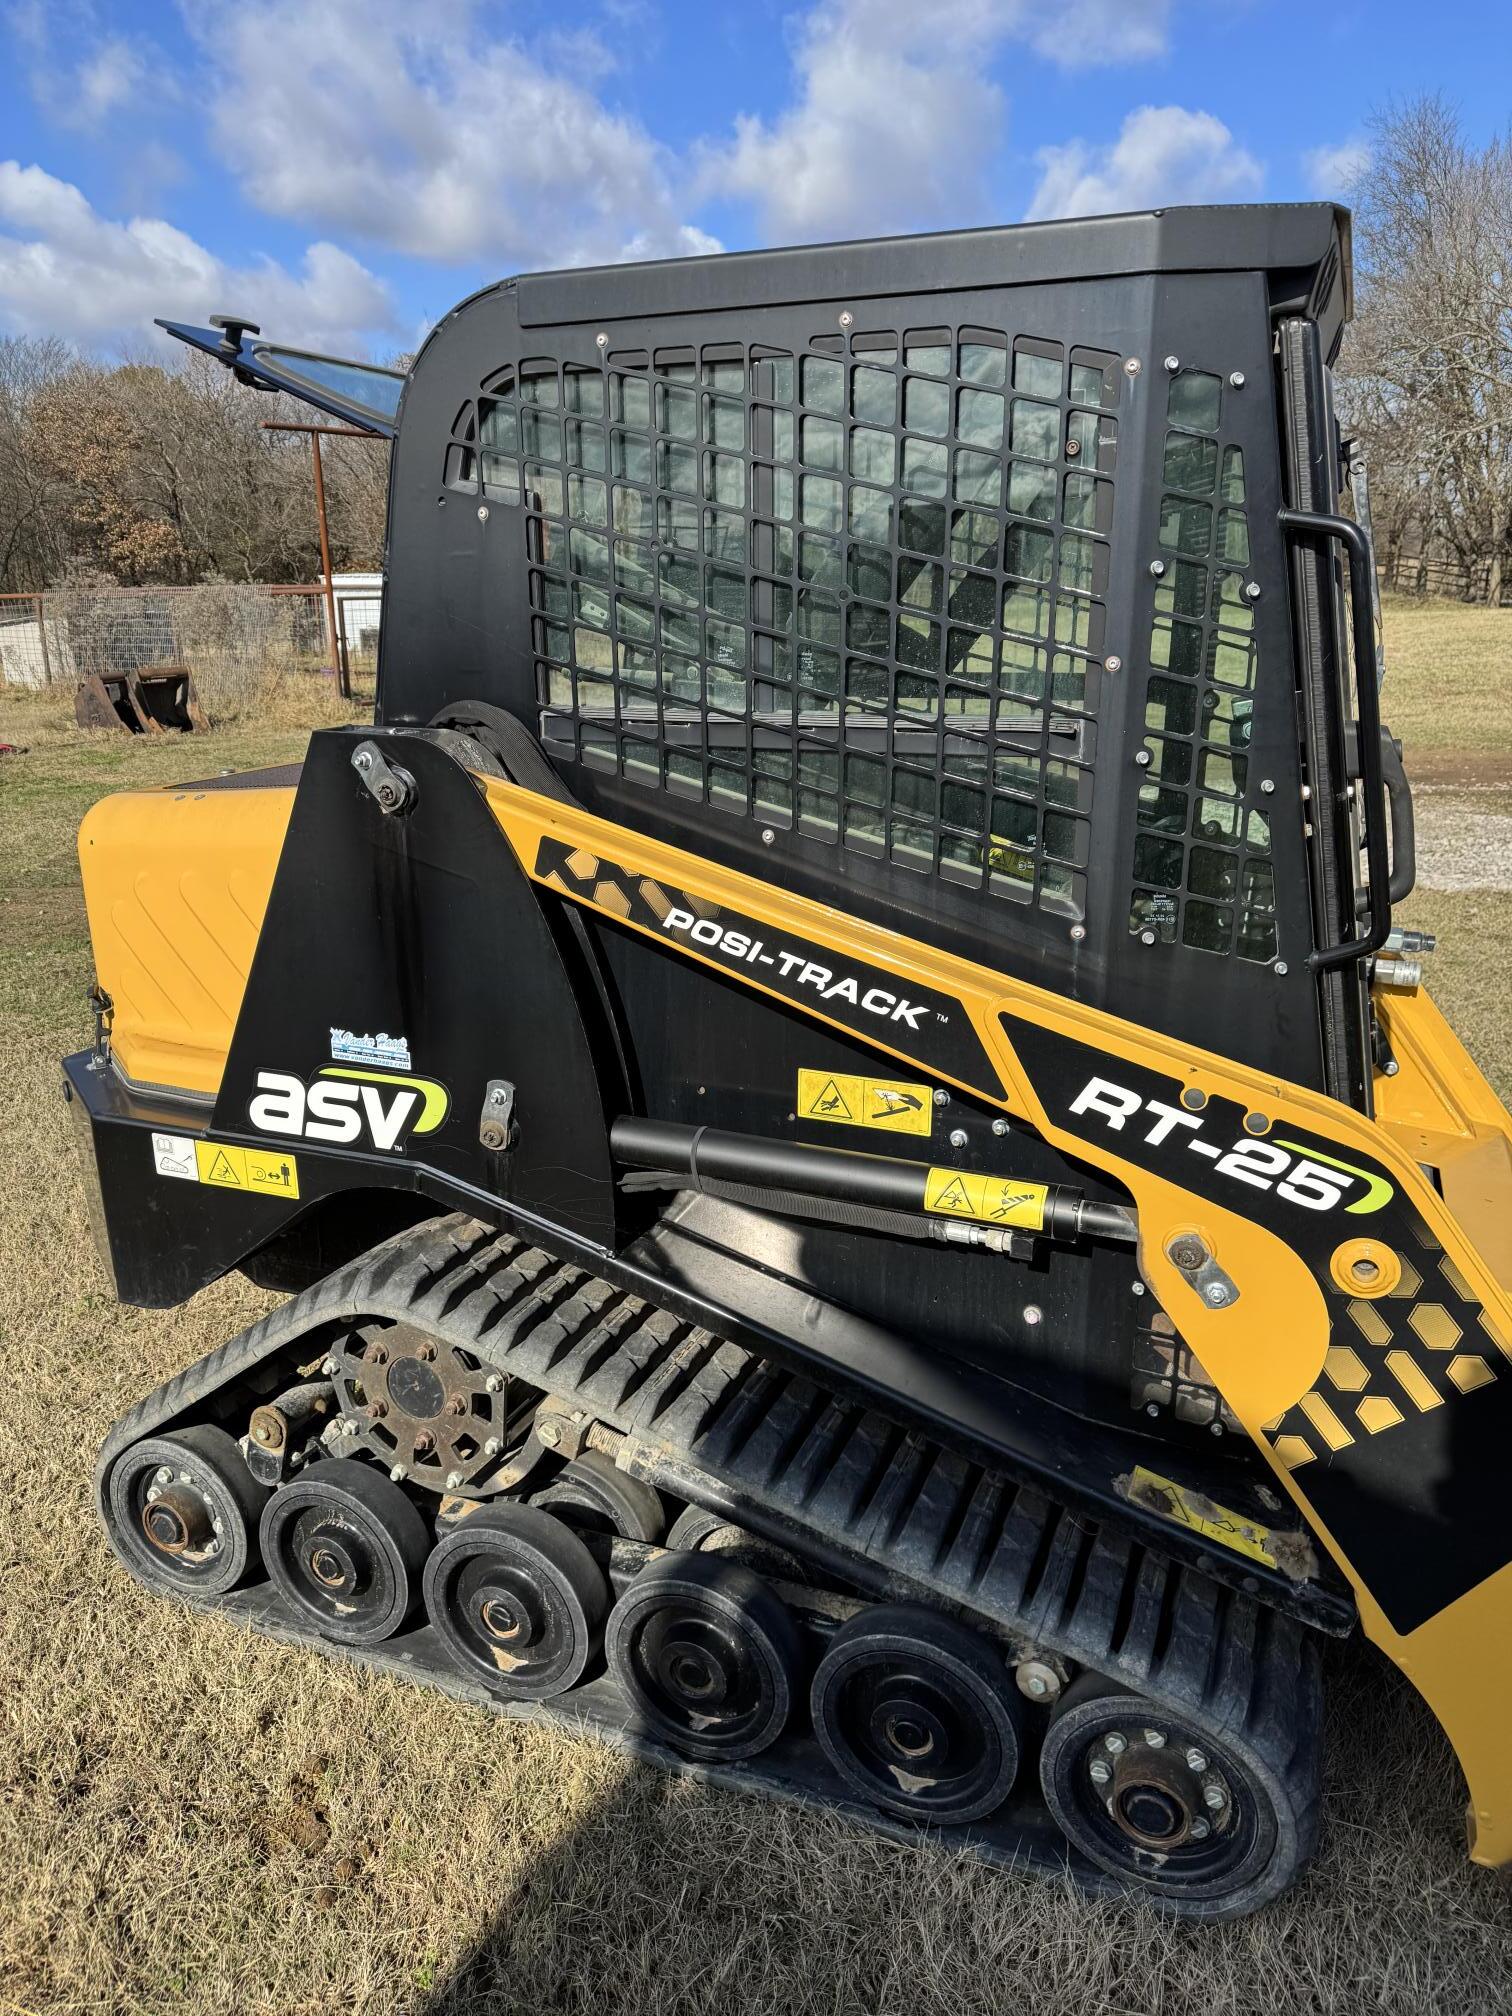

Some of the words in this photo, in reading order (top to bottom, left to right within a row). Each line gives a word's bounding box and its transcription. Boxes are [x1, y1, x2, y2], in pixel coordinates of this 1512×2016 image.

[662, 907, 931, 1030] POSI-TRACK
[343, 1032, 375, 1048] Vander
[1068, 1076, 1355, 1211] RT-25
